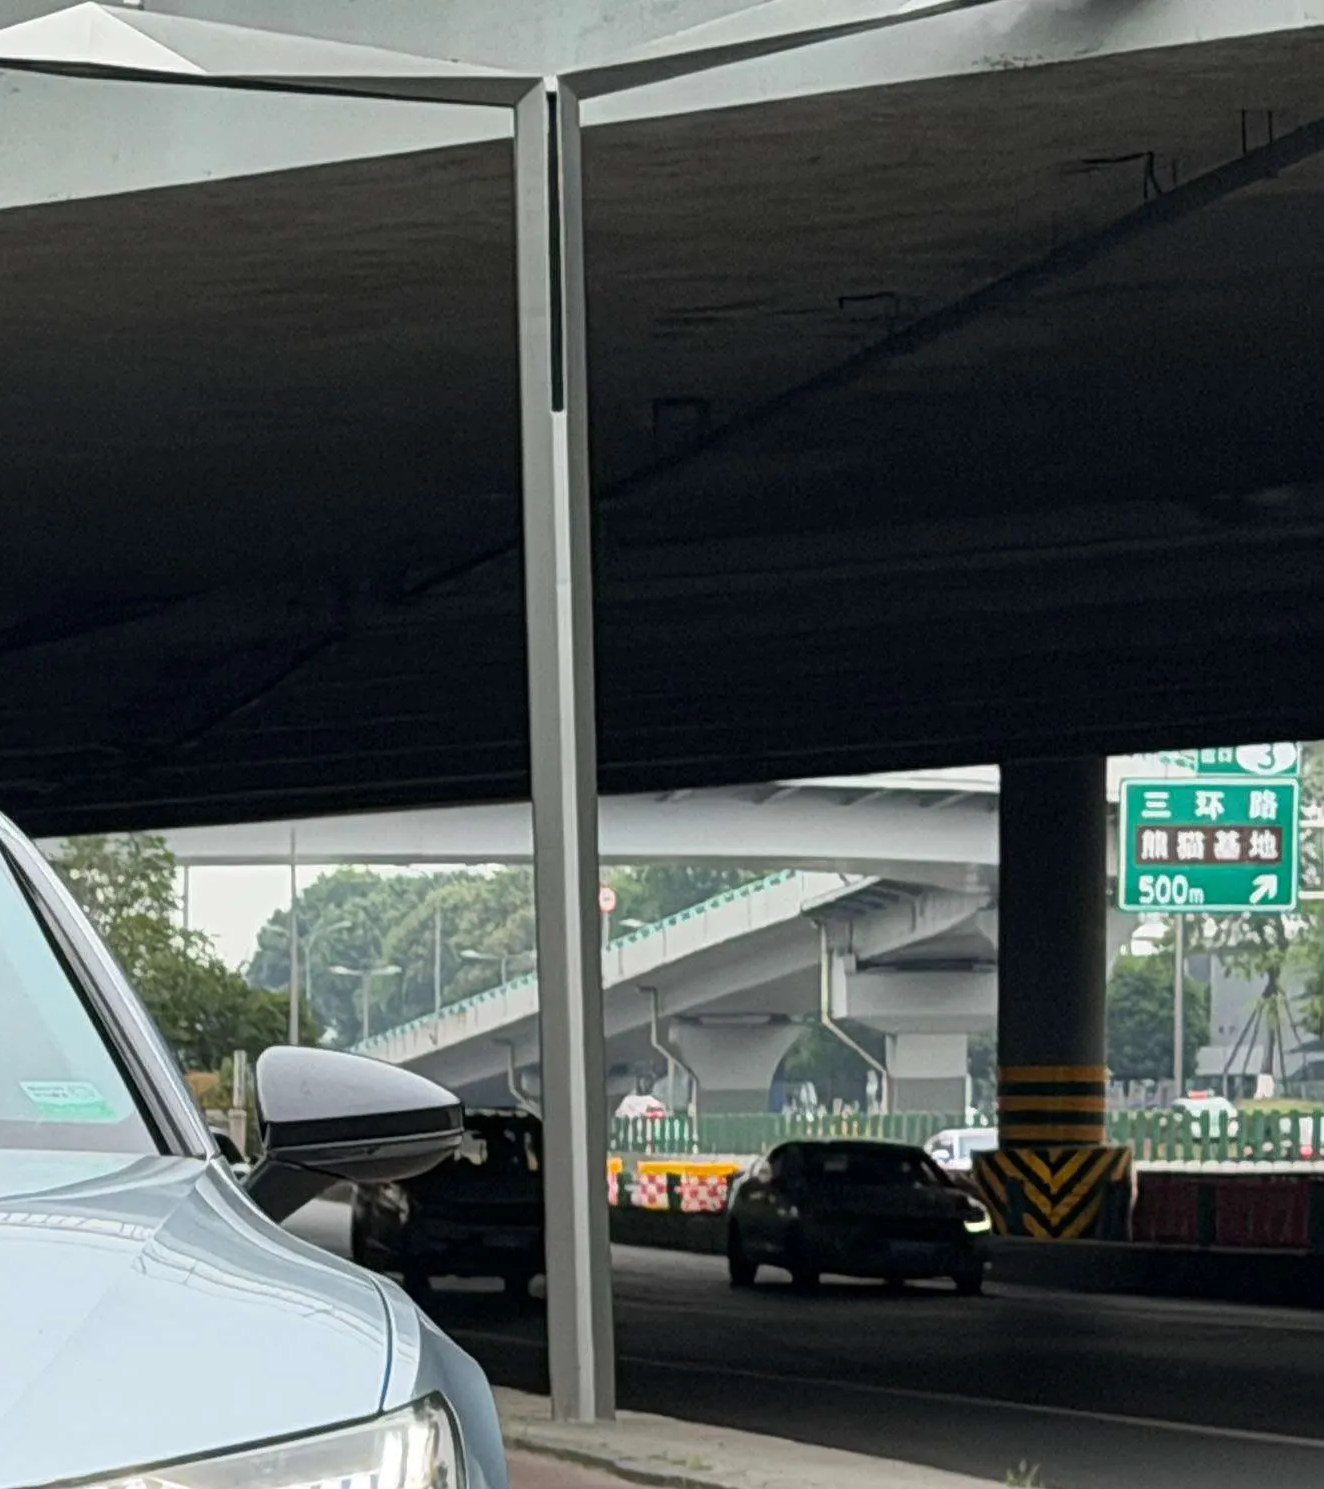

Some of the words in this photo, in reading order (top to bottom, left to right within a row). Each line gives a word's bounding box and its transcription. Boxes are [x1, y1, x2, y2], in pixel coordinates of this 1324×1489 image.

[1141, 789, 1278, 820] 三环路
[1140, 829, 1279, 860] 熊猫基地
[1138, 874, 1205, 904] 500m
